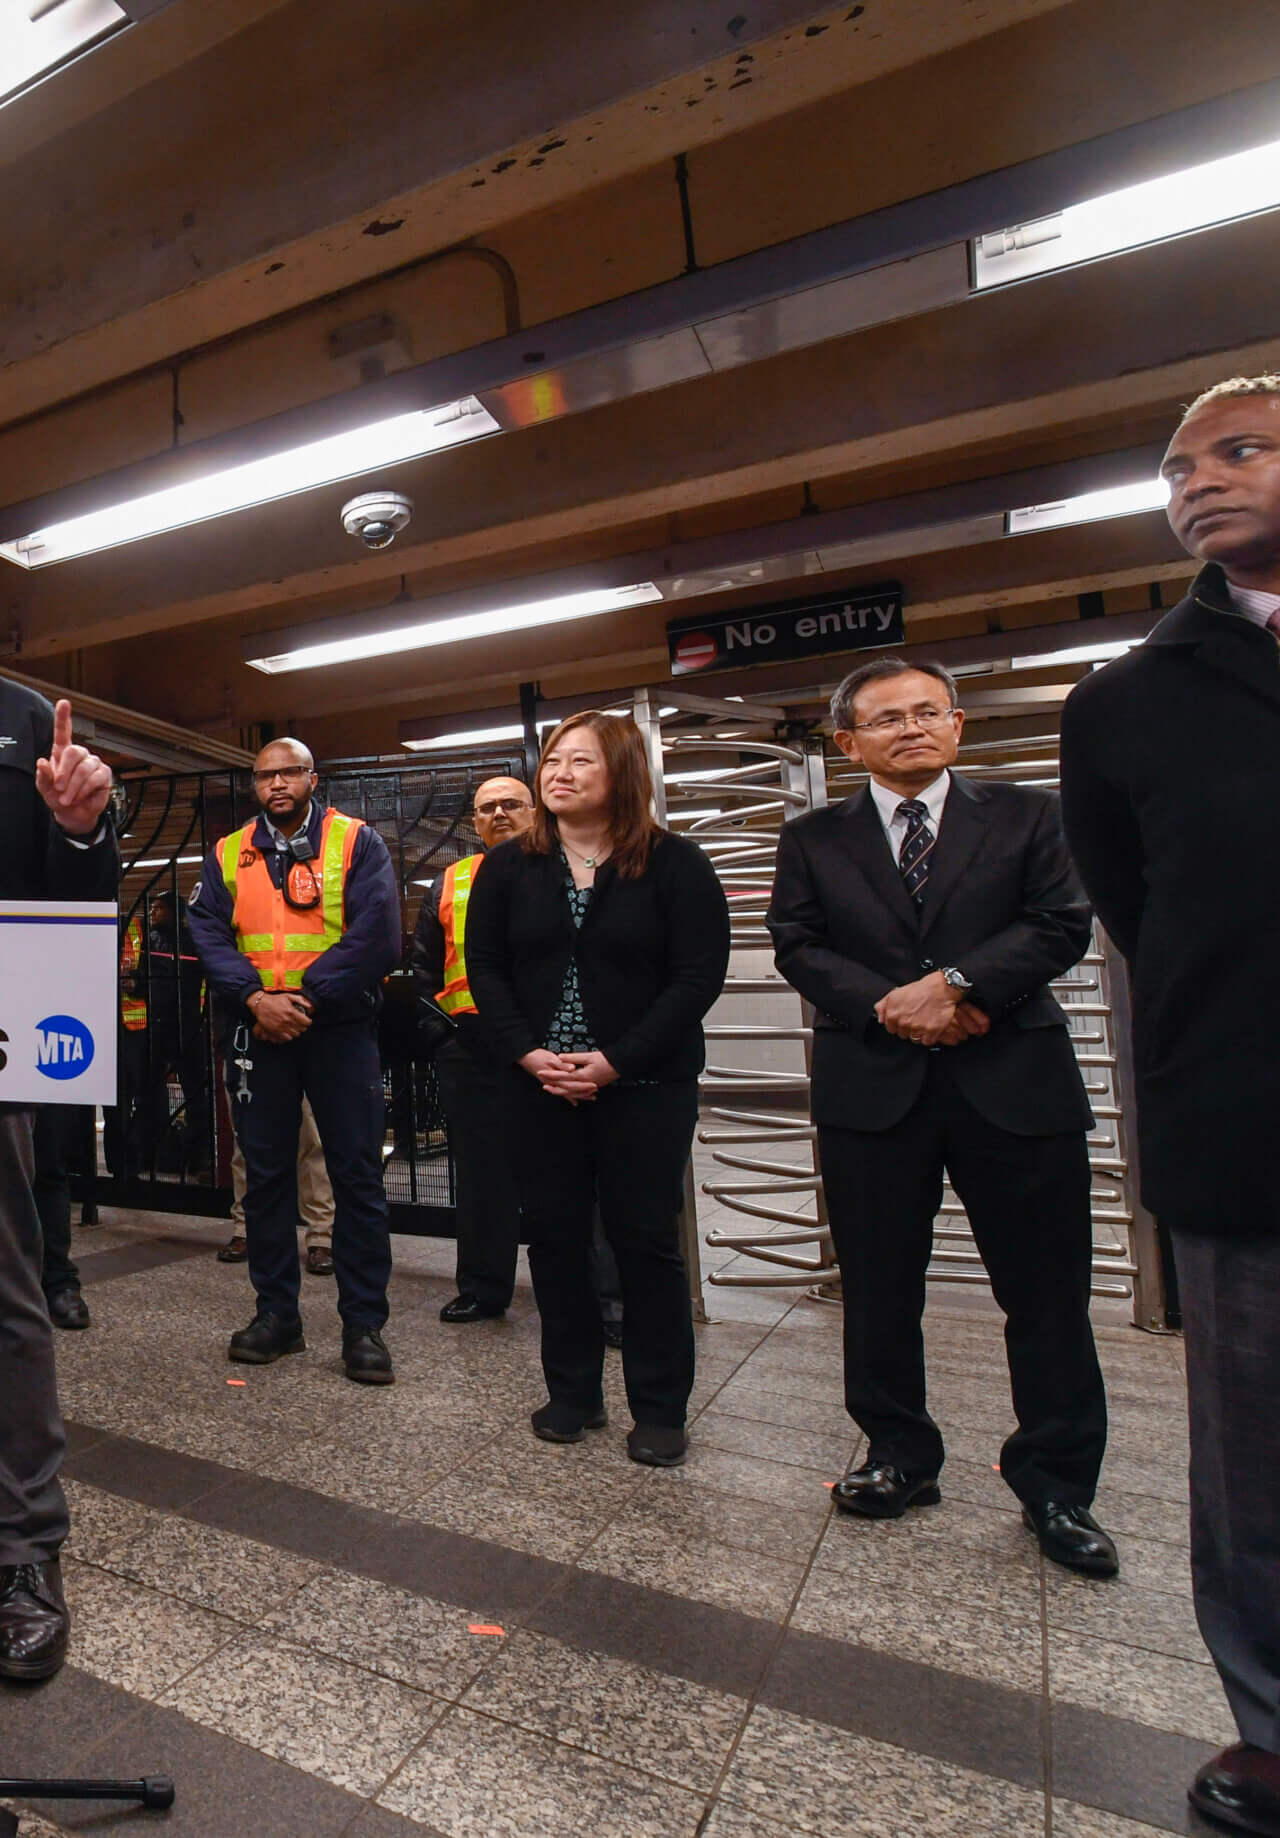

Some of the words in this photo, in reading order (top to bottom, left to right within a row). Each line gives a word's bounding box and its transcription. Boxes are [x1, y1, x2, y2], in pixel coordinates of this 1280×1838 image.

[724, 622, 777, 650] No
[794, 603, 896, 638] entry
[34, 1028, 84, 1067] MTA
